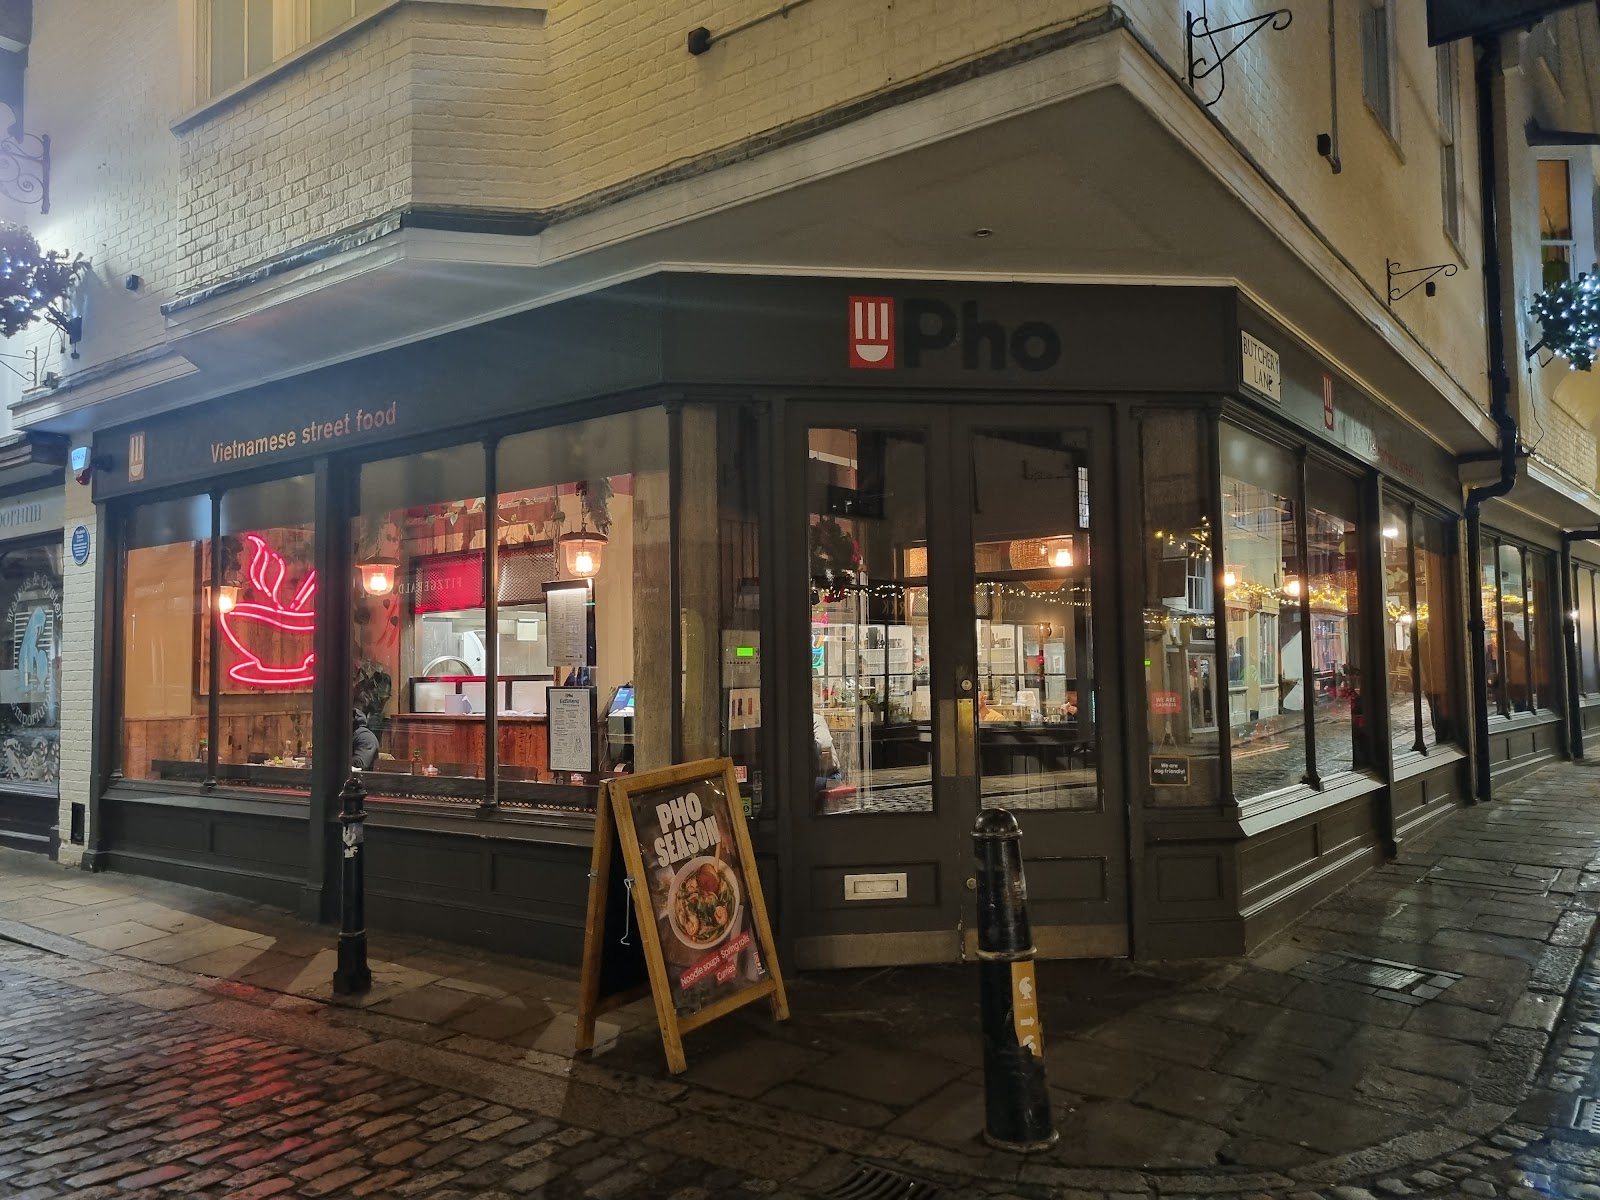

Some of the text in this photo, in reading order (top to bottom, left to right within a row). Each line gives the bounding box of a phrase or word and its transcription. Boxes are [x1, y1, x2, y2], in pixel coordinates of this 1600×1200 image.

[903, 298, 1062, 371] Pho
[1243, 336, 1279, 375] BUTCHERY
[1253, 365, 1273, 392] LANE
[210, 401, 397, 464] Vietnamese street food
[41, 574, 63, 622] Oyster
[656, 792, 702, 835] PHO
[654, 815, 721, 868] SEASON
[720, 934, 750, 959] Spring rolls
[680, 955, 721, 987] Noodle soups
[716, 964, 736, 981] Curries
